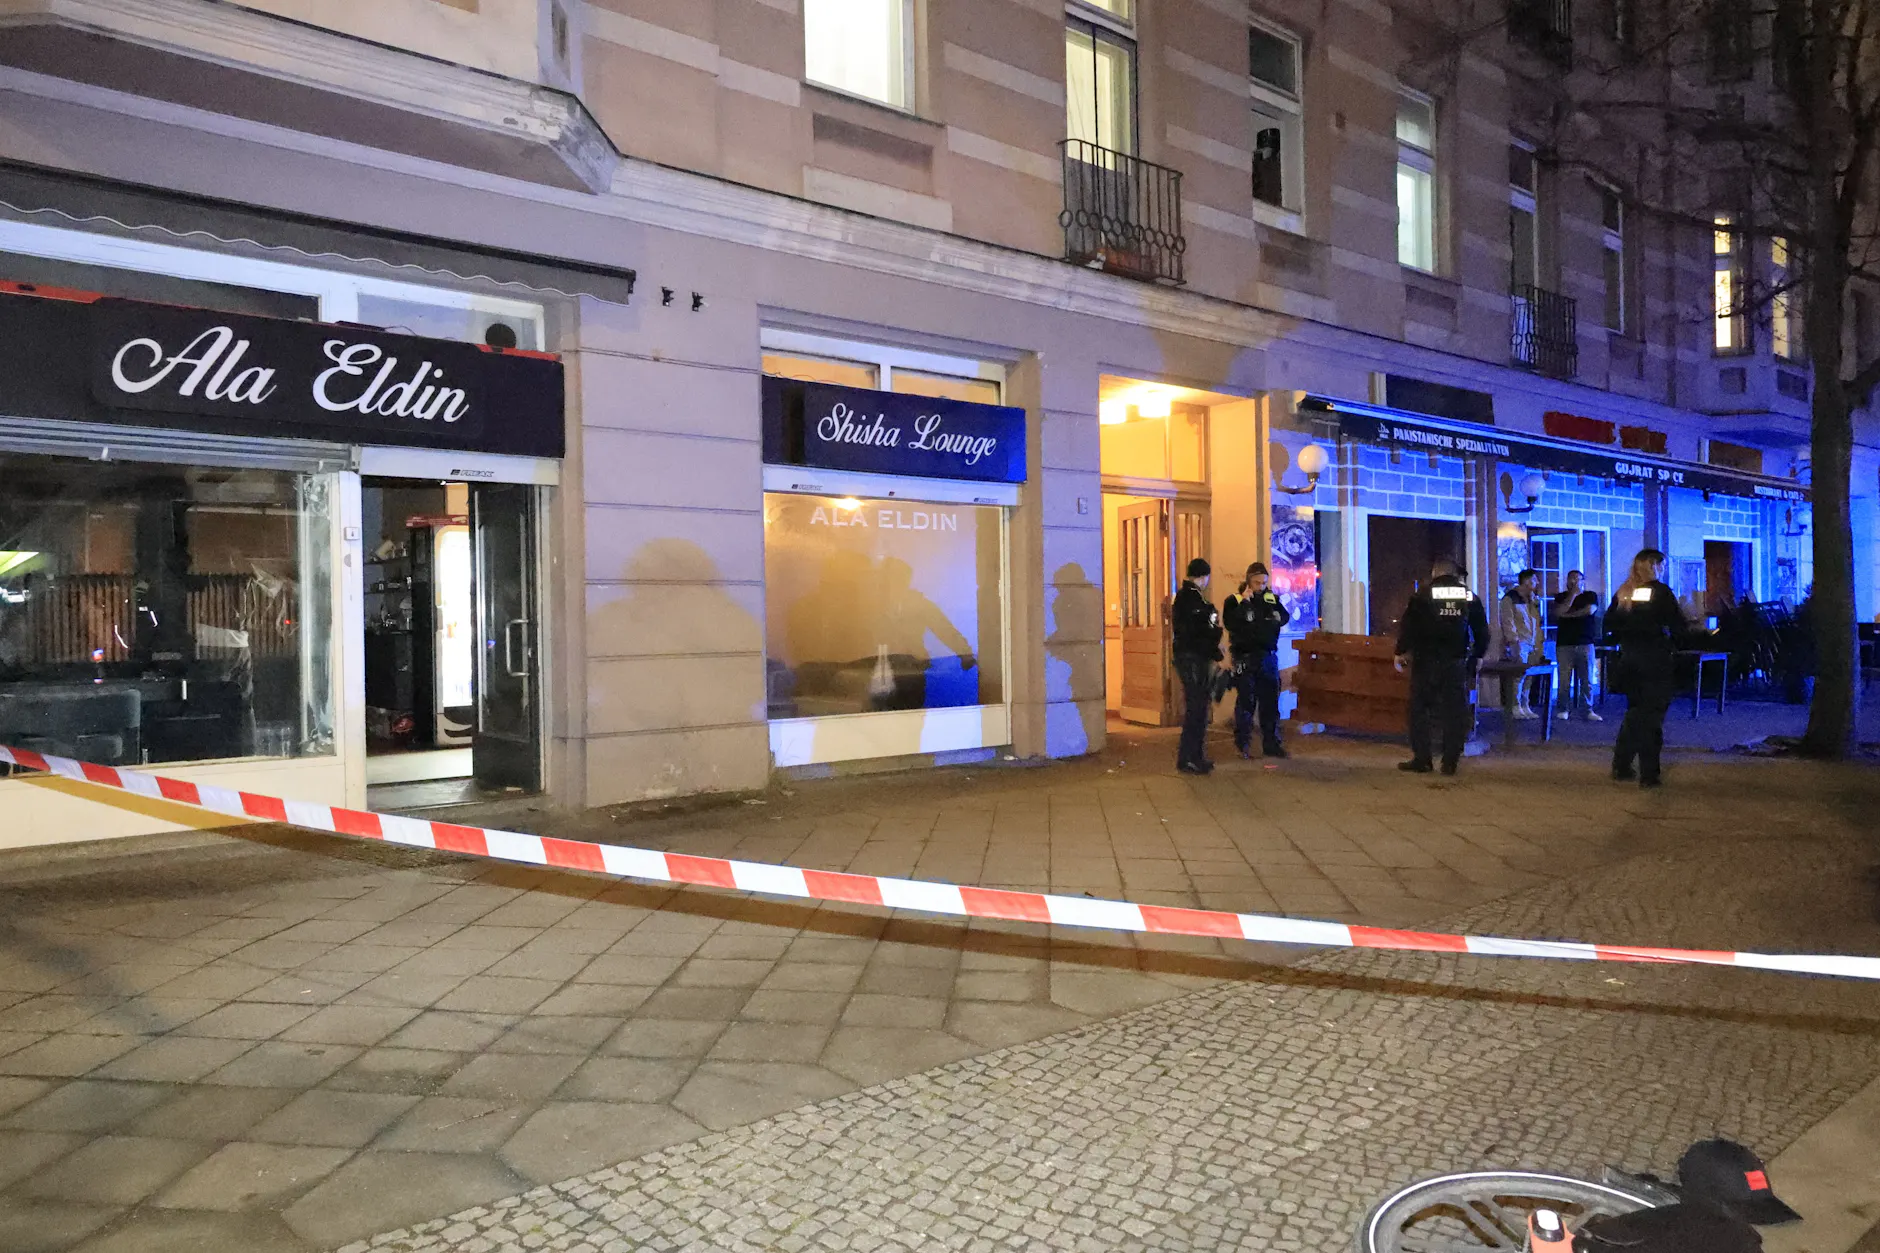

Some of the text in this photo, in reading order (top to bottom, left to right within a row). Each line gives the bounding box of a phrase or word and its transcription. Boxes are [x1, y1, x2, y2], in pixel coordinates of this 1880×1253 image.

[111, 326, 469, 423] Ala Eldin
[817, 402, 997, 466] Shisha Lounge
[1393, 427, 1453, 448] PAKISTANISCHE
[1615, 461, 1684, 484] GUJRAT SPCE
[810, 506, 957, 531] ALA ELDIN
